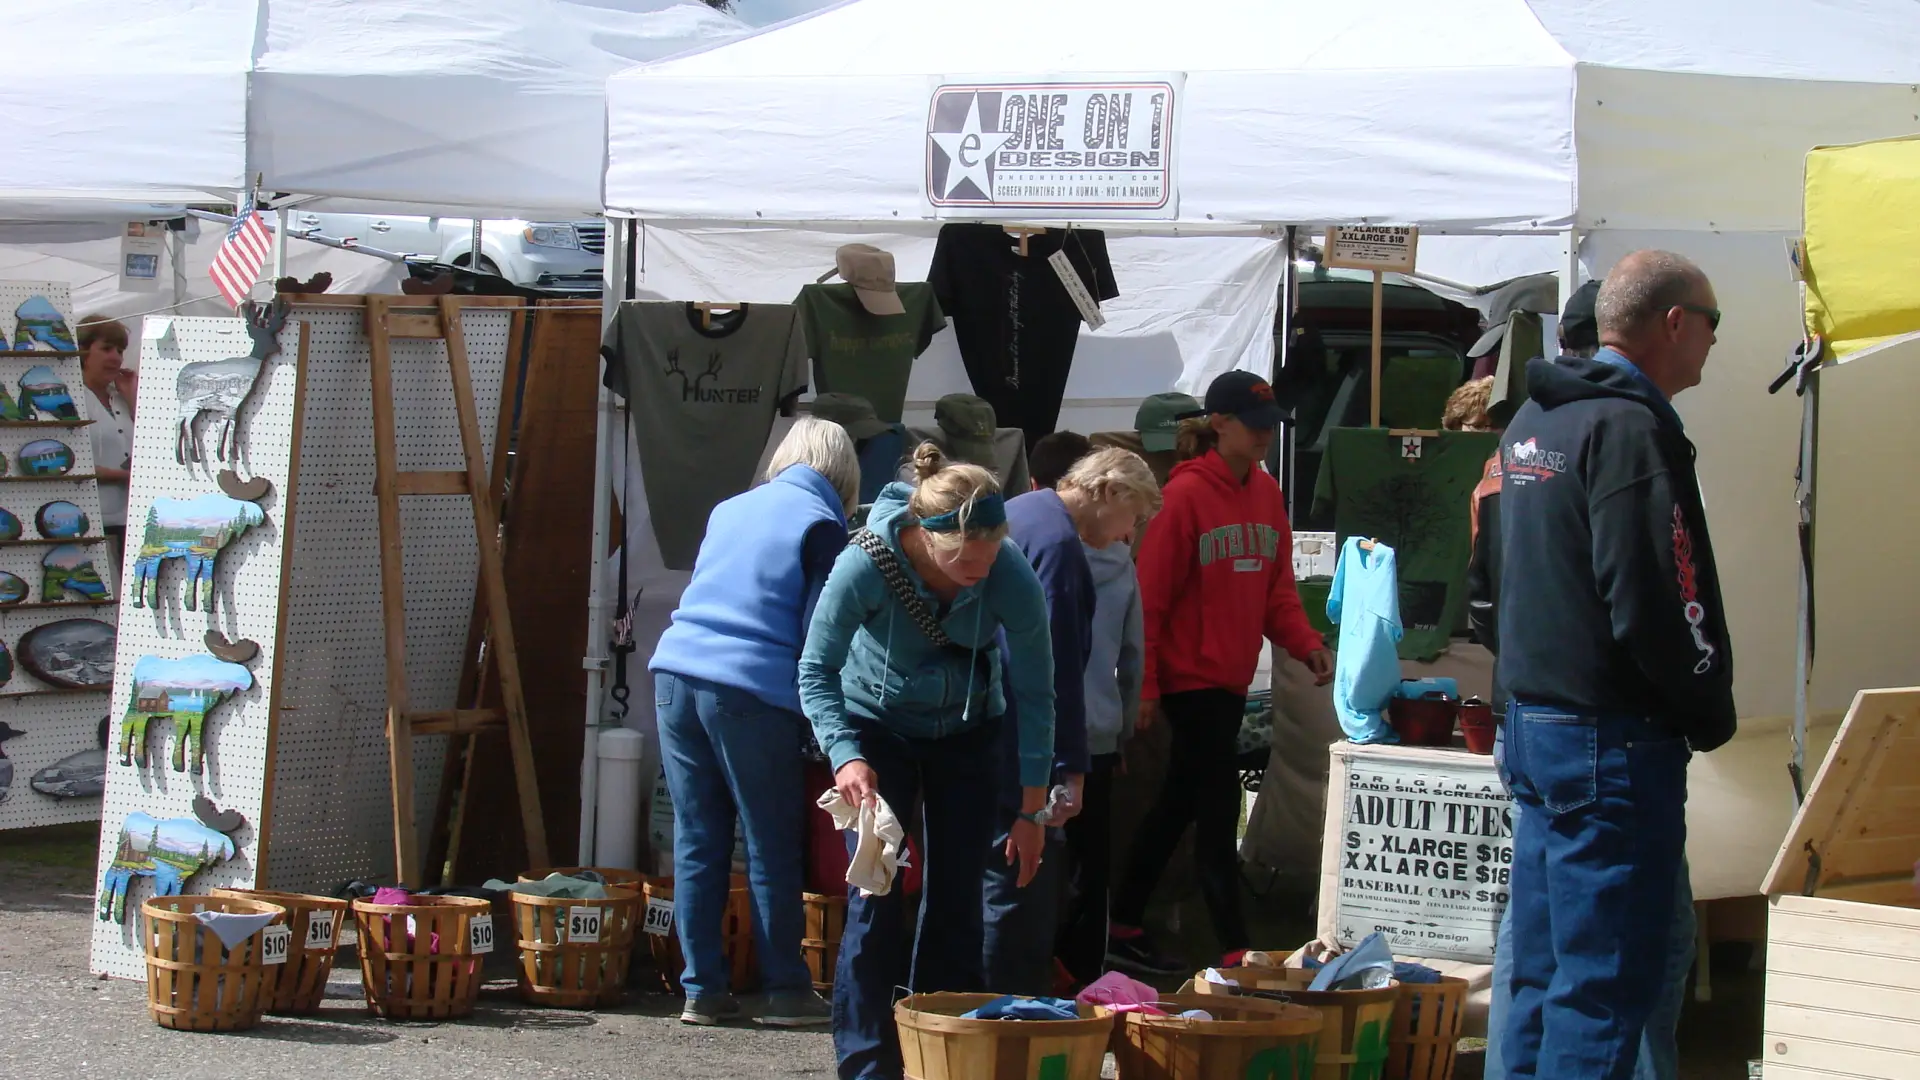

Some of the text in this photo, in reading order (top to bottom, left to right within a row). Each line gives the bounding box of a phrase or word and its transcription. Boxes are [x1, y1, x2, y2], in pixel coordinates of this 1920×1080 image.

[1003, 92, 1165, 150] ONE ON 1
[999, 151, 1160, 168] DESIGN
[997, 185, 1160, 198] SCREEN PRINTING BY A HUMAN NOT A MACHINE
[1341, 232, 1405, 243] XXLARGE $18
[682, 378, 760, 404] HUNTER
[1350, 773, 1492, 793] ORIGINA
[1350, 781, 1390, 792] HAND
[1394, 785, 1428, 795] SILK
[1348, 794, 1513, 839] ADULT TEES
[1346, 831, 1513, 864] S XLARGE $16
[1344, 851, 1510, 885] XXLARGE $18
[1344, 877, 1509, 904] BASEBALL CAPS $10
[571, 916, 598, 935] $10
[647, 906, 671, 928] $10
[311, 922, 331, 941] $10
[472, 926, 492, 946] $10
[1374, 924, 1398, 935] ONE
[1401, 928, 1416, 937] on
[1427, 931, 1469, 943] Design
[264, 935, 286, 956] $10
